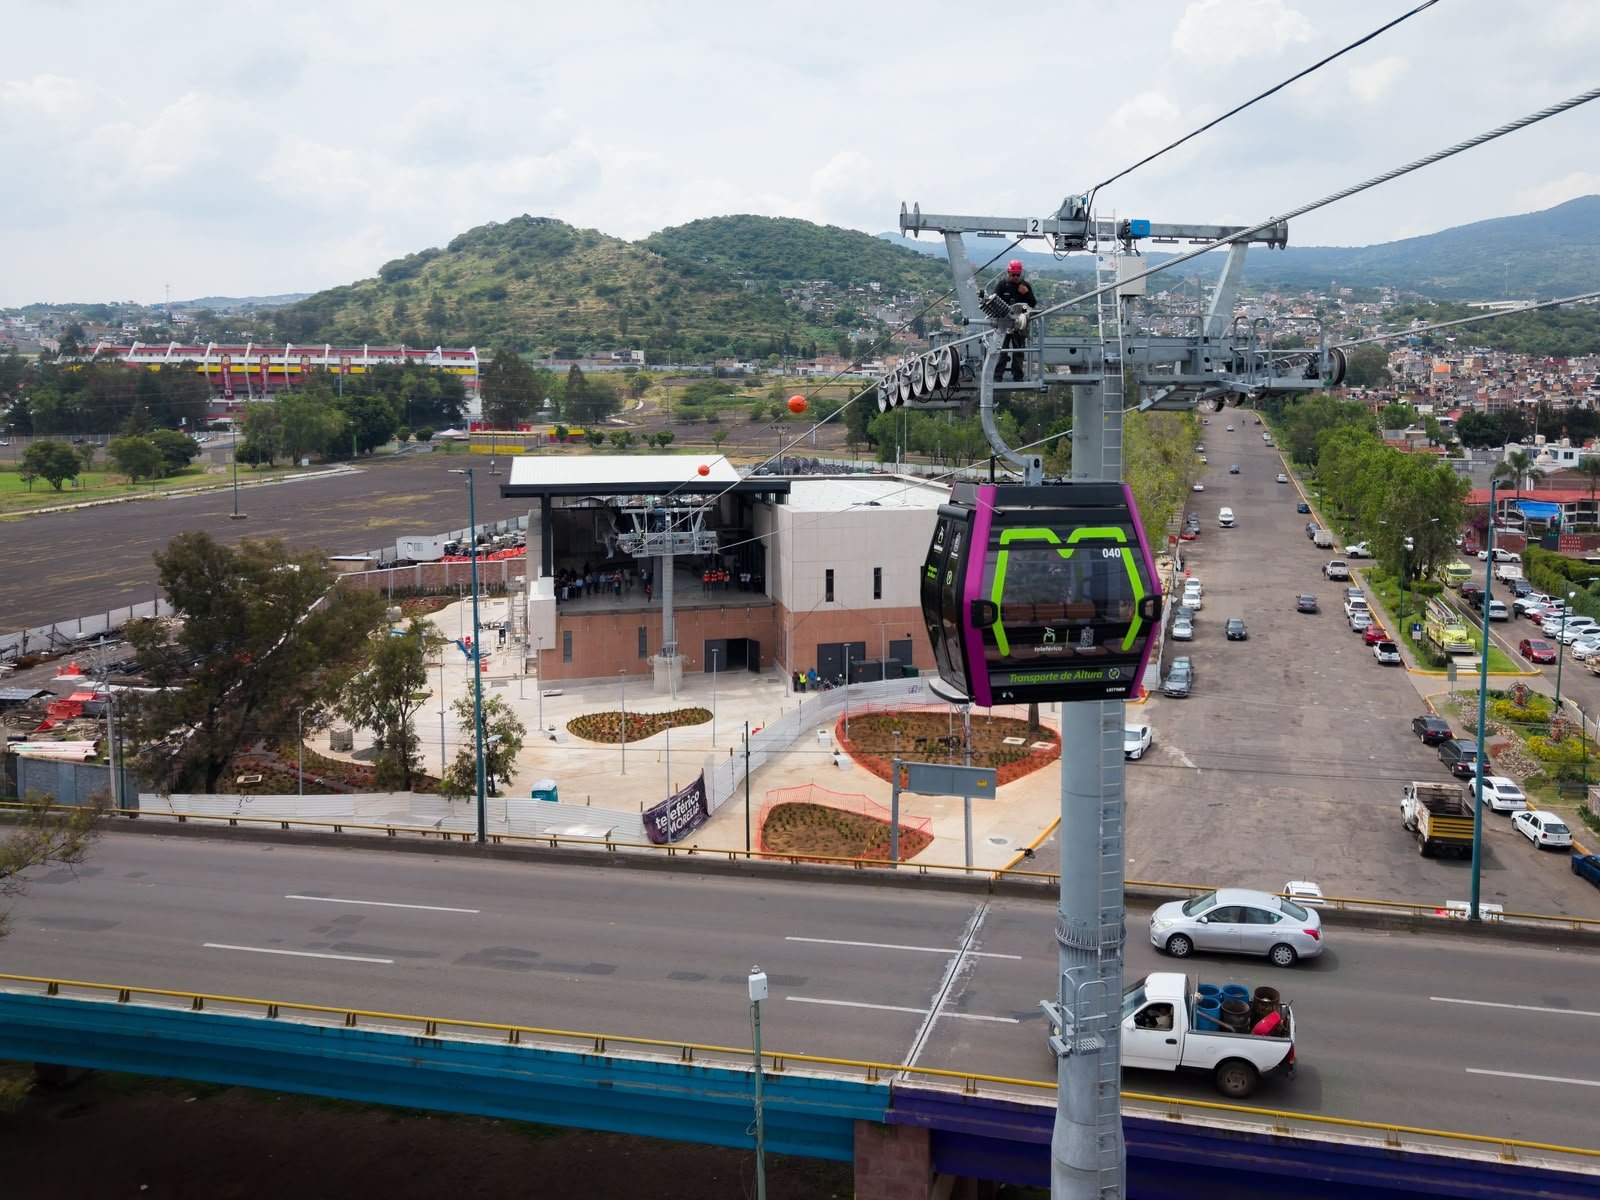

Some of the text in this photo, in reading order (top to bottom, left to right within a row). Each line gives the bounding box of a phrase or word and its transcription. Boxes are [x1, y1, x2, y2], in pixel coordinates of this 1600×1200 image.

[1031, 219, 1039, 232] 2
[1102, 547, 1121, 558] 040
[1009, 669, 1104, 683] Transporte de Altura
[669, 802, 700, 833] MORELIA
